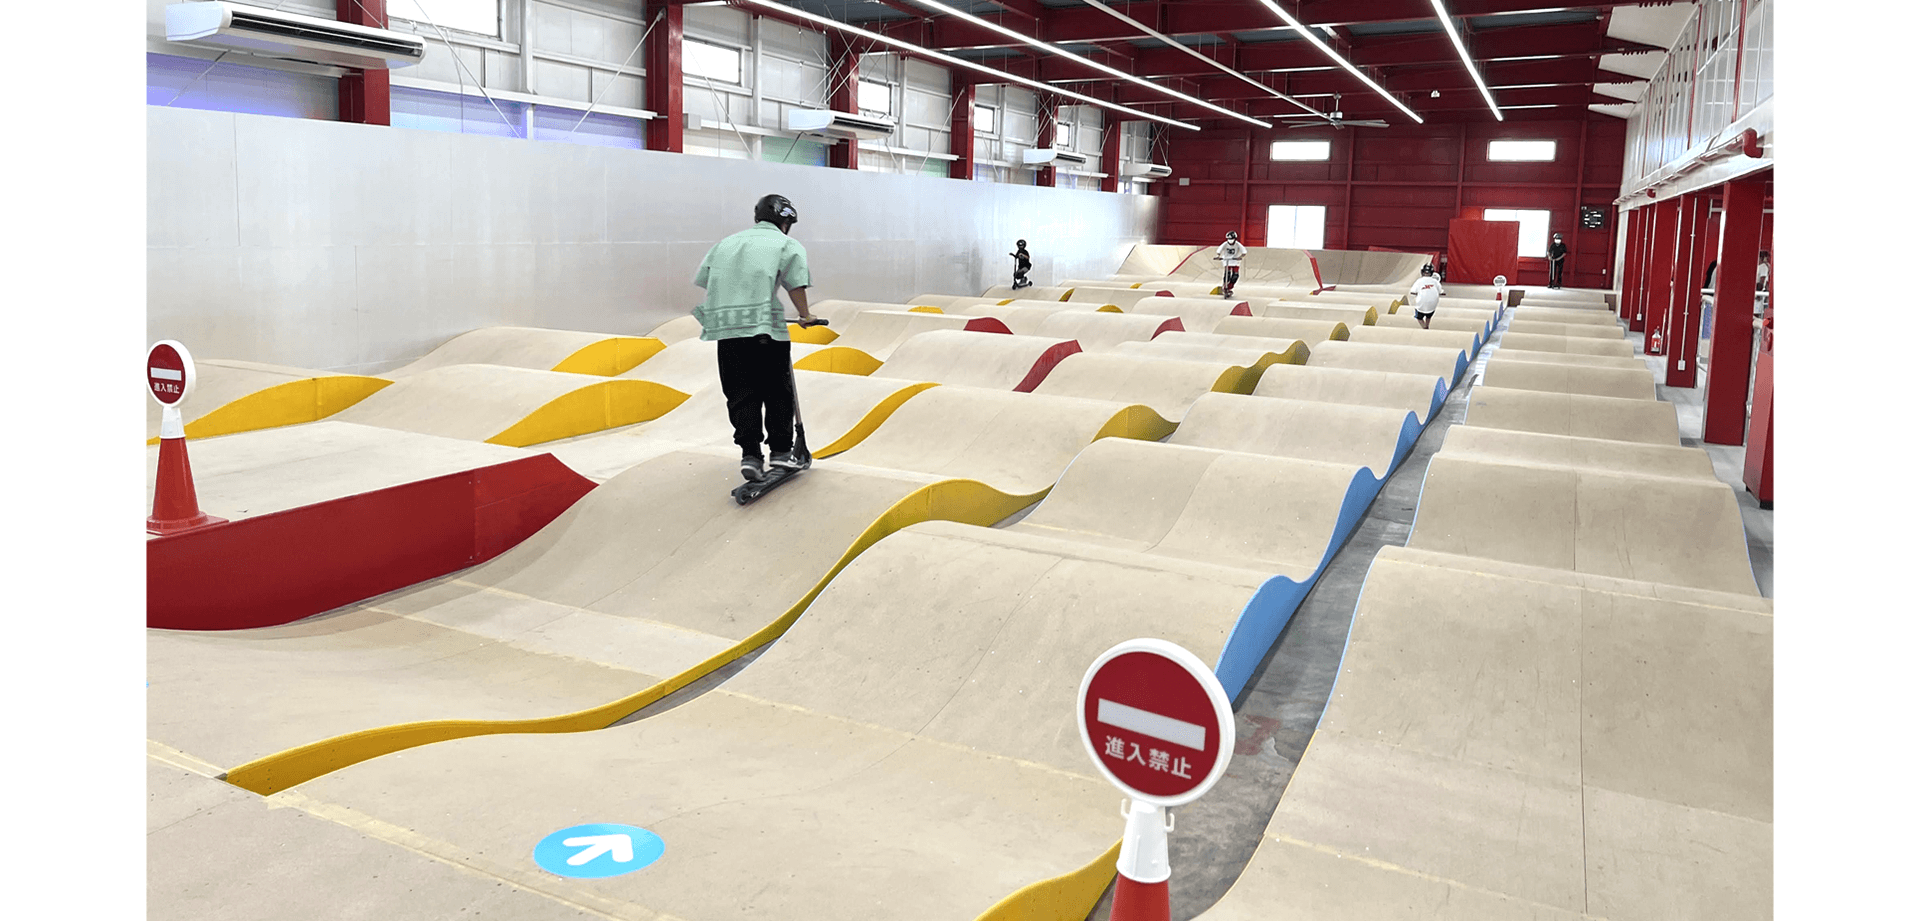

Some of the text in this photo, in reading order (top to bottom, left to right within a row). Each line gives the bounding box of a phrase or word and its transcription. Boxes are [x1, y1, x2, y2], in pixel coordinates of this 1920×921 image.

[154, 382, 180, 394] 進入禁止
[1104, 735, 1192, 779] 進入禁止
